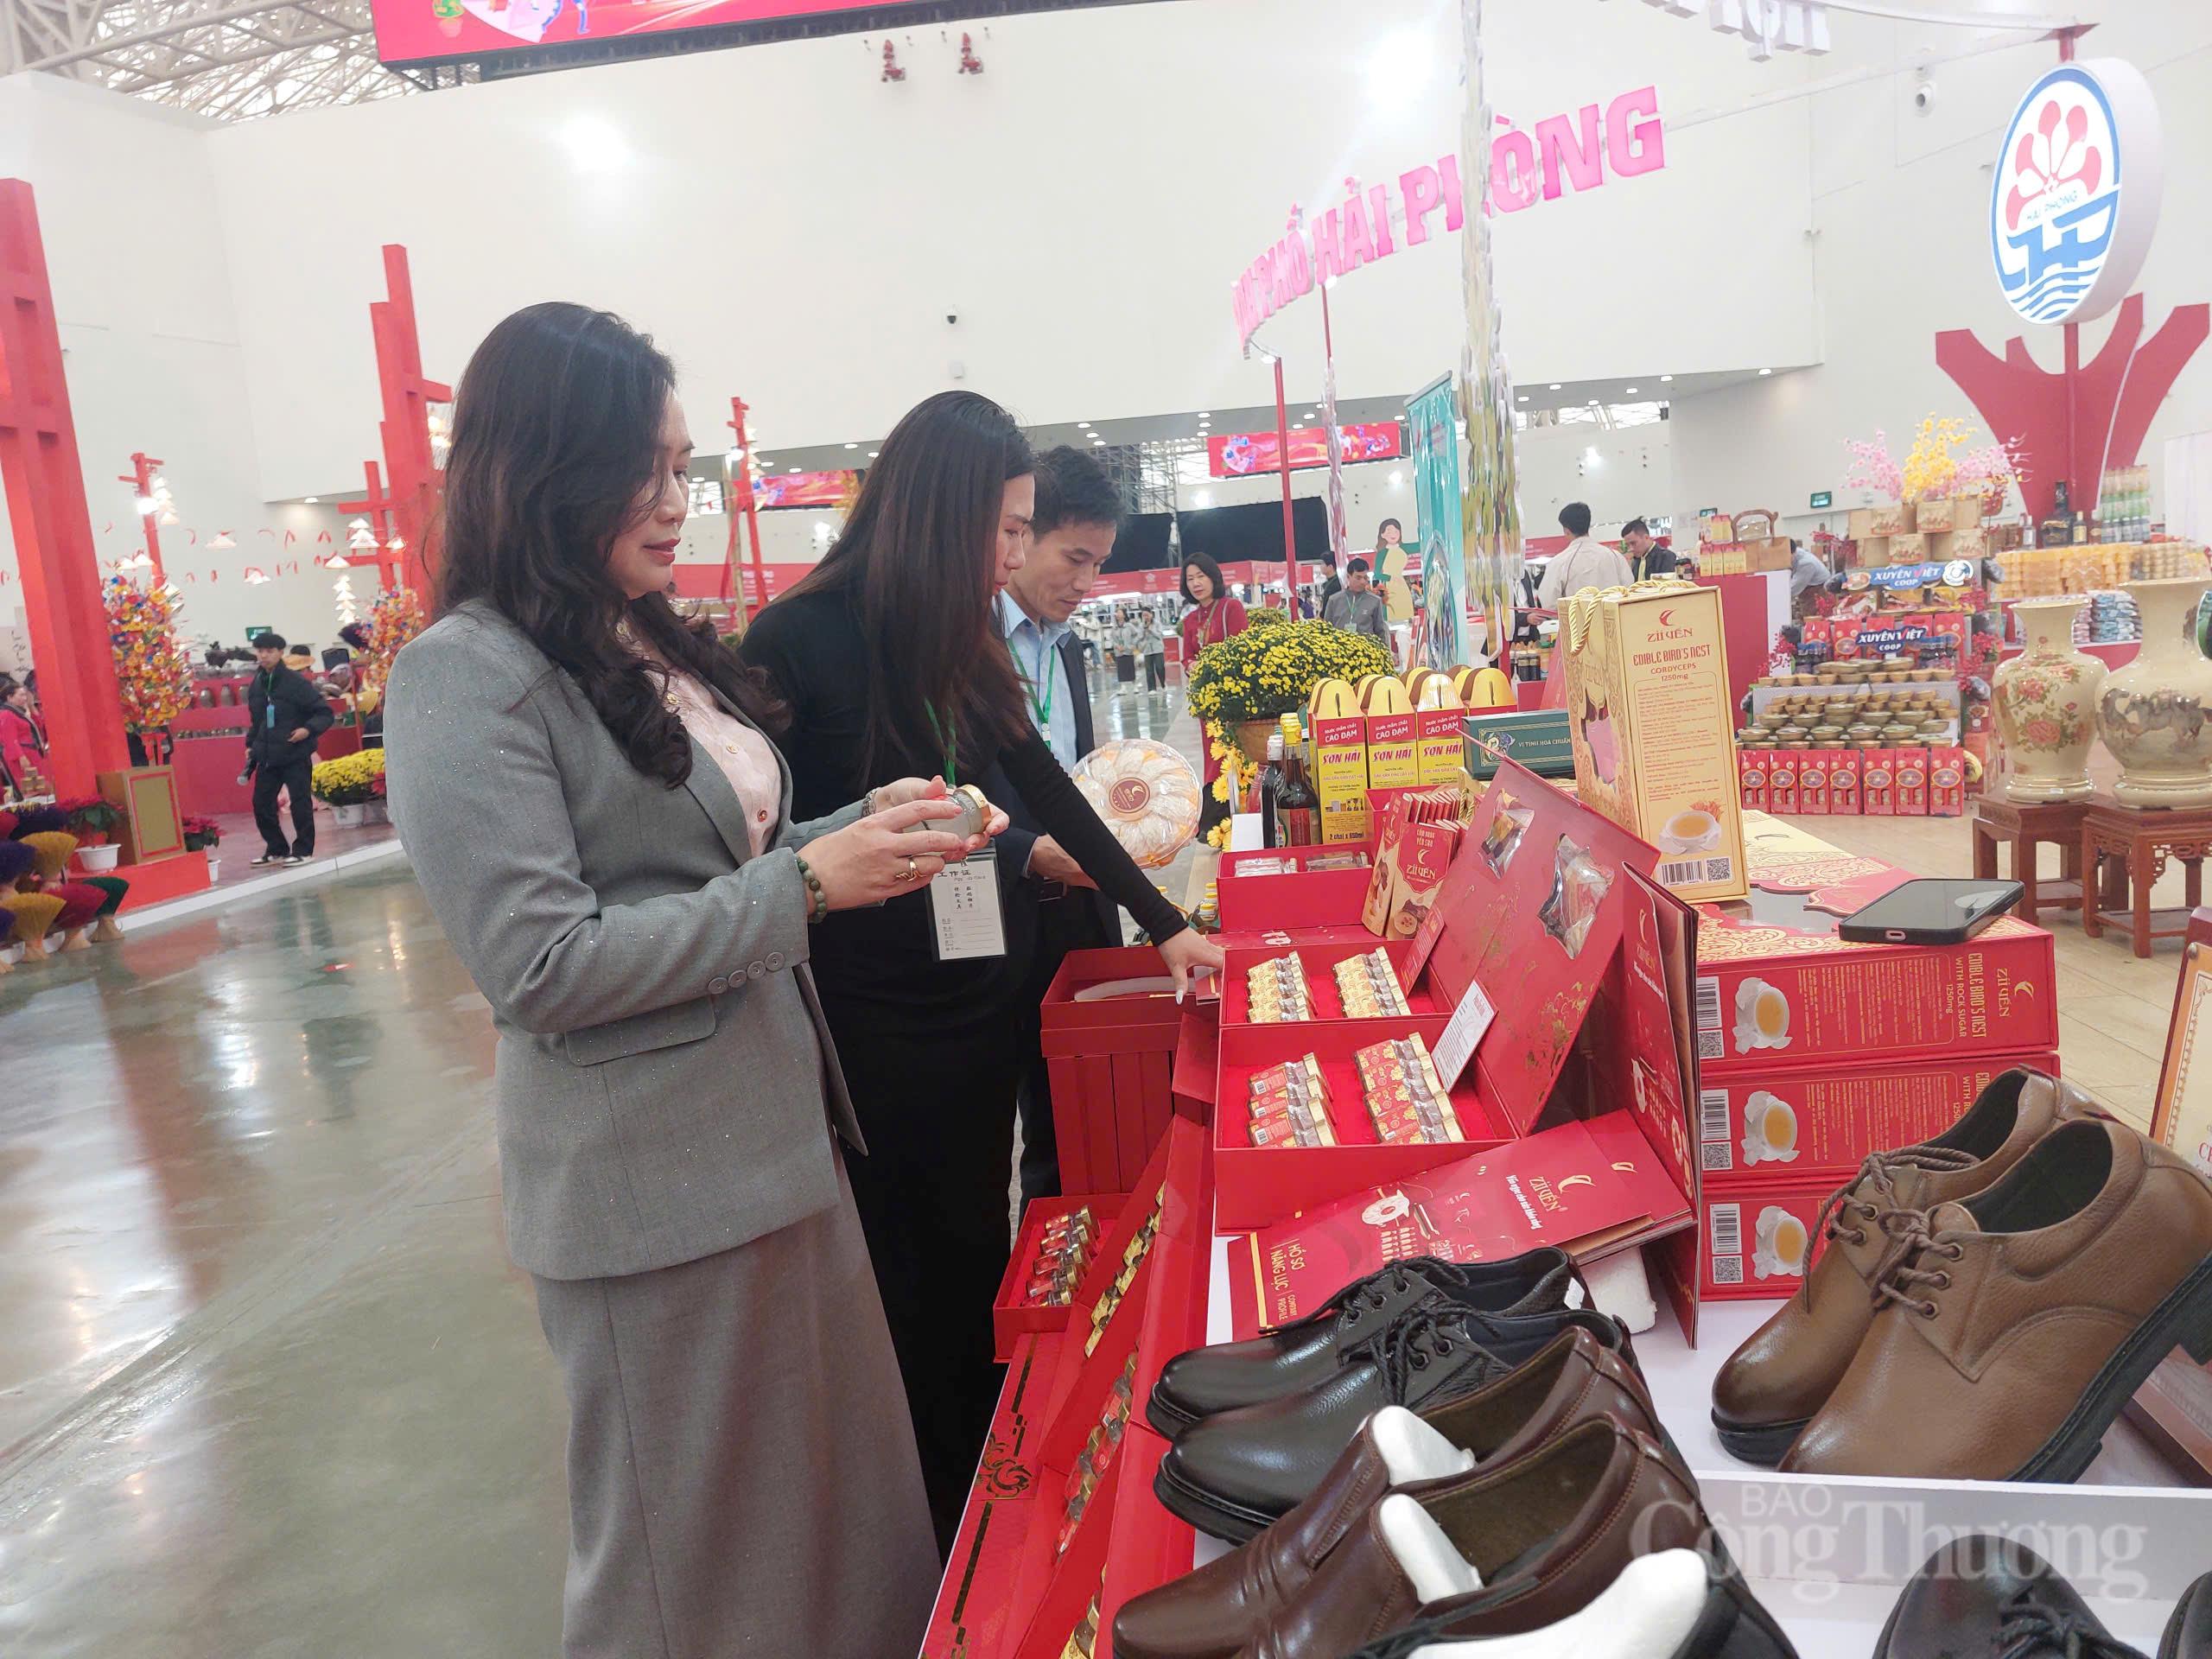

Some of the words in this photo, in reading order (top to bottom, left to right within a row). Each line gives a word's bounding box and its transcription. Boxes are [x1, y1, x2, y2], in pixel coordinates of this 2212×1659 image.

[1311, 176, 1394, 286] HẢI
[1874, 569, 1912, 582] XUYÊN
[1914, 566, 1941, 578] VIỆT
[1859, 630, 1896, 644] XUYÊN
[1897, 627, 1923, 640] VIỆT
[1633, 652, 1662, 666] EDIBLE
[1663, 648, 1688, 662] BIRD'S
[1690, 645, 1711, 658] NEST
[1650, 663, 1697, 675] CORDYCEPS
[1325, 734, 1340, 743] CAO
[1341, 729, 1357, 741] ĐẠM
[1376, 731, 1390, 741] CAO
[1391, 727, 1408, 738] ĐẠM
[1426, 725, 1440, 734] CAO
[1442, 721, 1459, 733] ĐẠM
[1955, 957, 1964, 980] WITH
[1968, 953, 1983, 985] EDIBLE
[1945, 983, 1954, 1014] 1250mg
[1956, 982, 1965, 1007] ROCK
[1970, 985, 1985, 1014] BIRD'S
[1958, 1008, 1967, 1038] SUGAR
[1971, 1015, 1986, 1038] NEST
[1962, 1076, 1971, 1099] WITH
[1270, 1249, 1287, 1274] NĂNG
